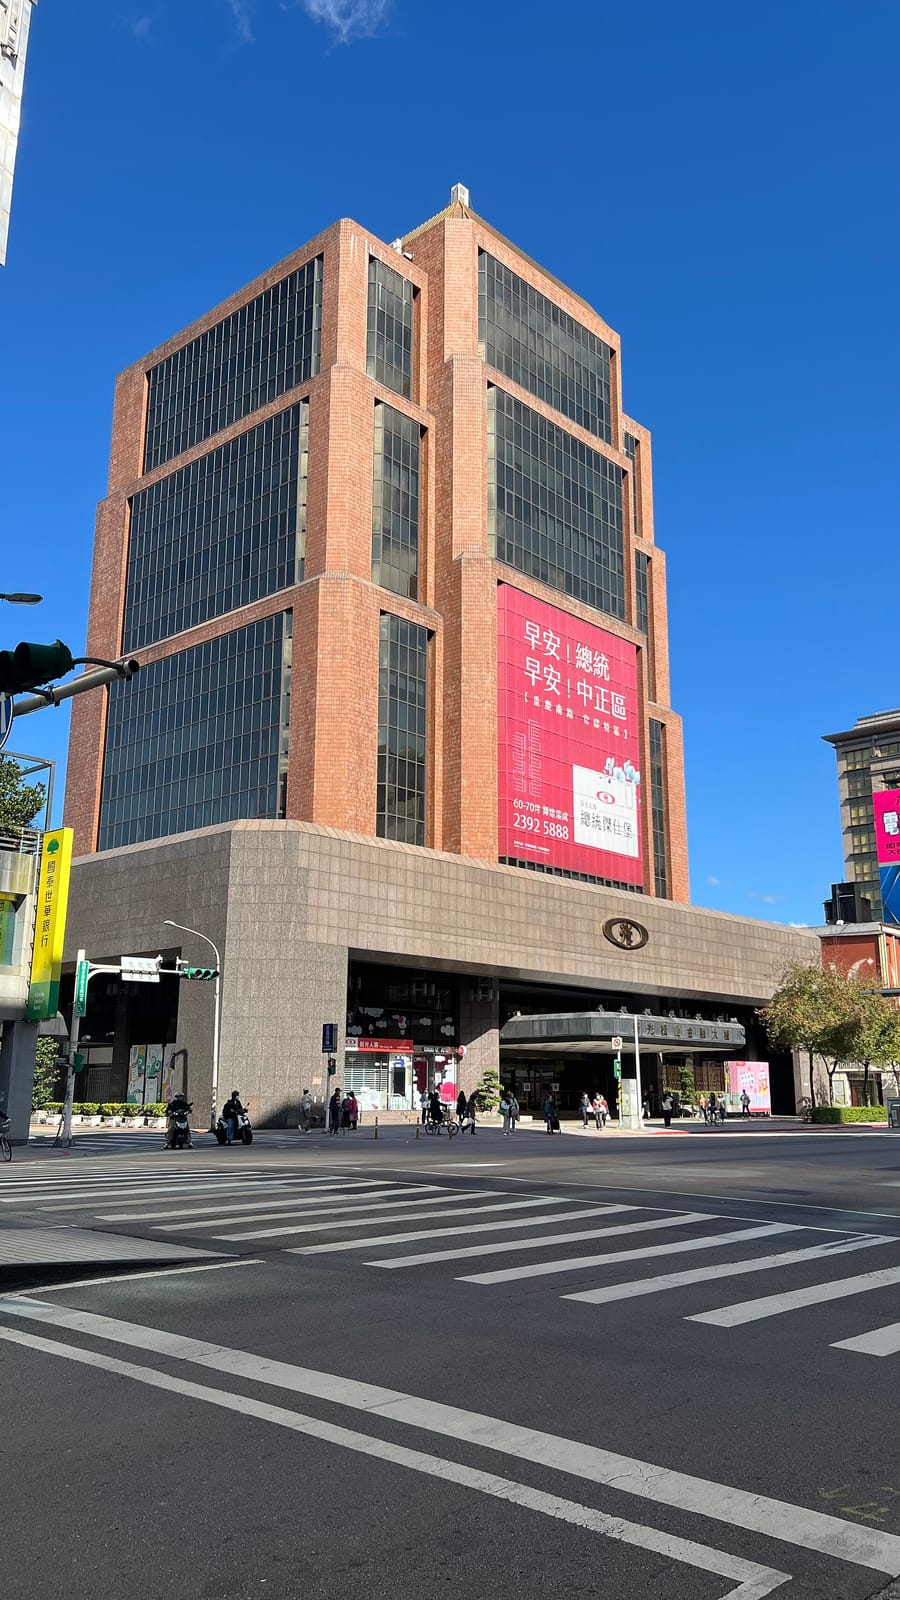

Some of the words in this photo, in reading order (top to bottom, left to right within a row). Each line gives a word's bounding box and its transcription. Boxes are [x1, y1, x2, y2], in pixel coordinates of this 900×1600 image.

[524, 620, 610, 681] 早安！總統
[524, 657, 627, 720] 早安！中正區
[513, 813, 540, 832] 2392
[543, 821, 569, 840] 5888
[41, 860, 56, 948] 國泰世華銀行
